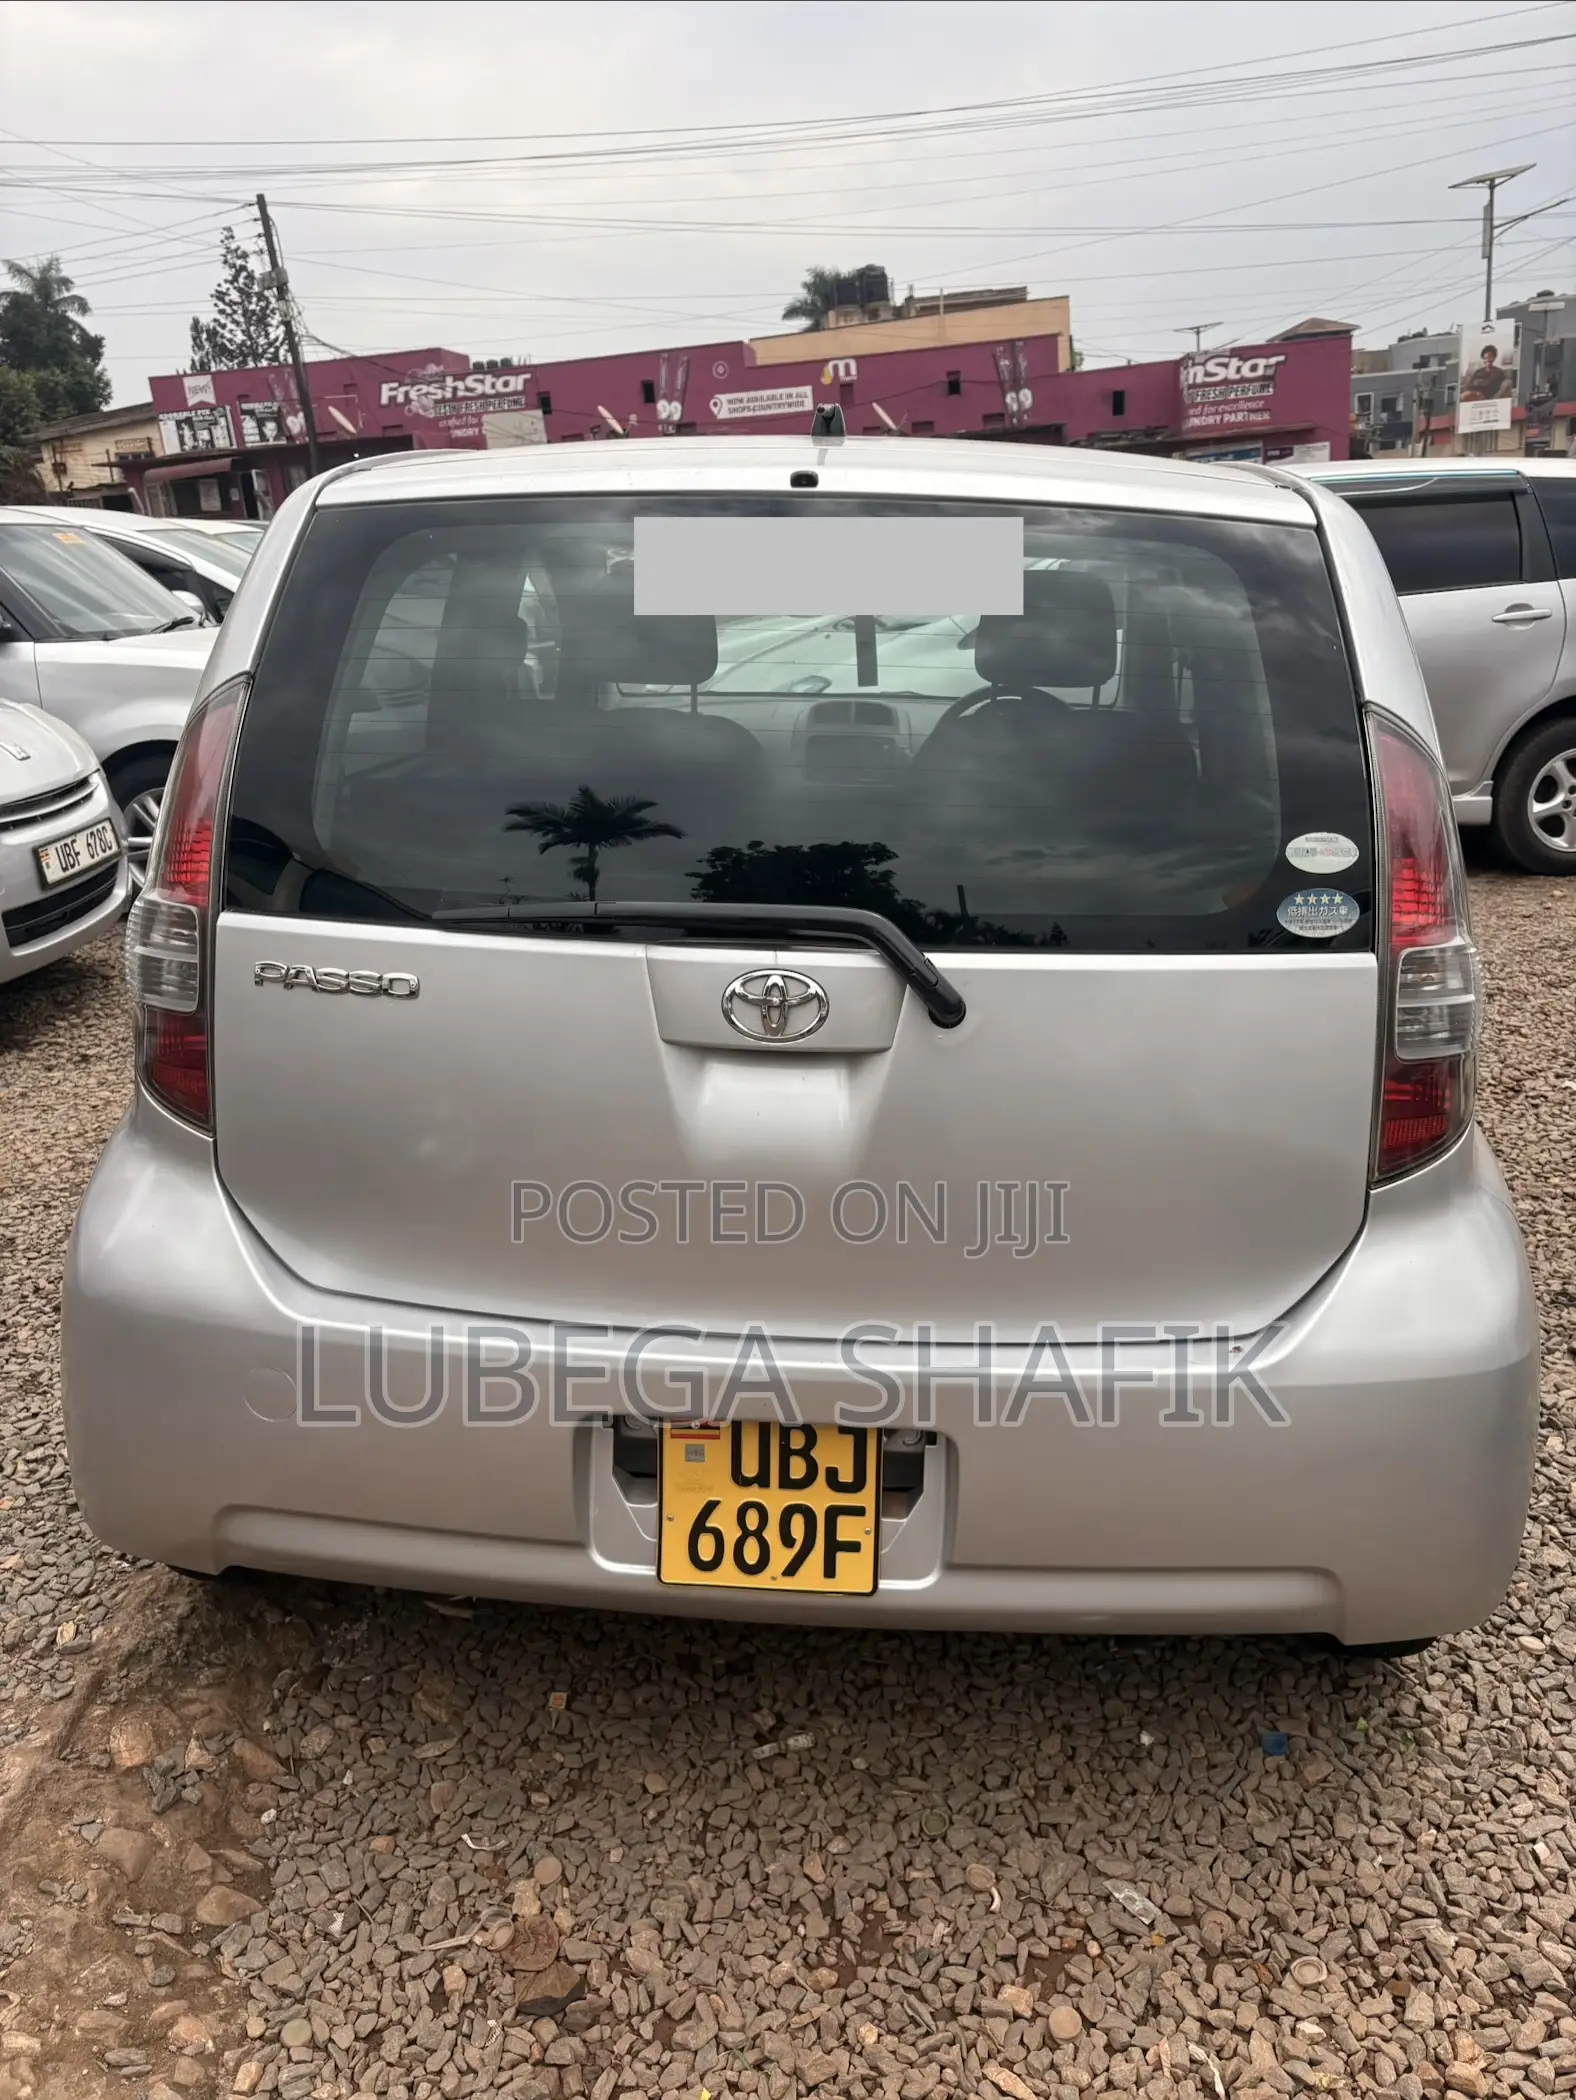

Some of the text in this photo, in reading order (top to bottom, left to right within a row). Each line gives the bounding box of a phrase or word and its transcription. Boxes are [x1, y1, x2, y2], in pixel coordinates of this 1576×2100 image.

[380, 373, 531, 405] FreshStar
[55, 825, 113, 873] UBF 678C
[254, 960, 420, 1000] PASSO
[731, 1420, 868, 1494] UBJ
[687, 1499, 867, 1579] 689F
